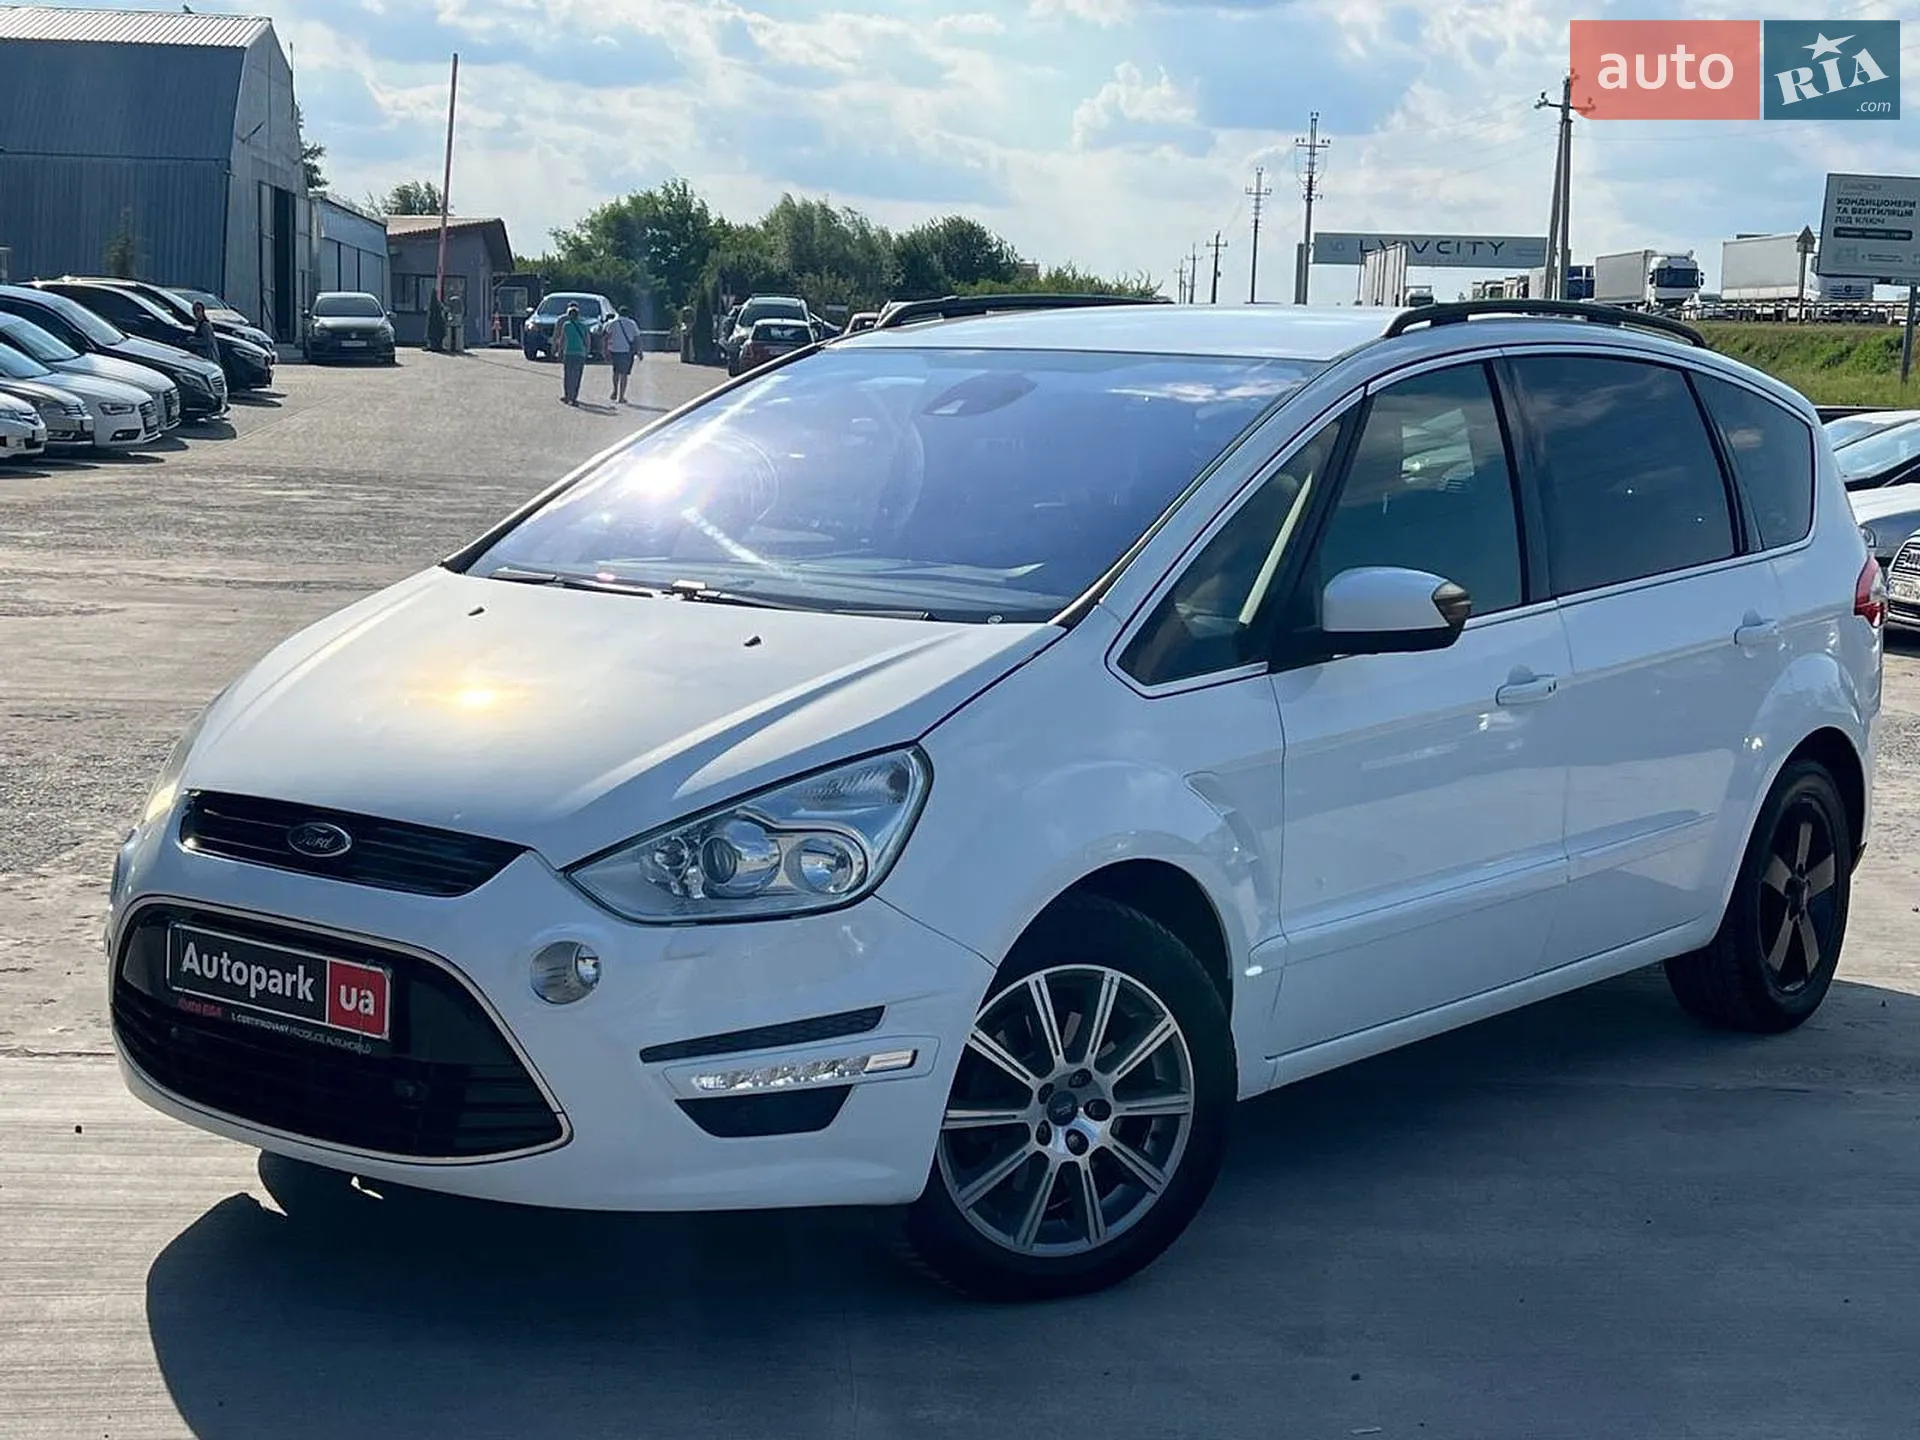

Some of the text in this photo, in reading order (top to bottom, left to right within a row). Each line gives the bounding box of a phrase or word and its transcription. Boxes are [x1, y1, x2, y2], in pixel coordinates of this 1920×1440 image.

[1835, 206, 1848, 215] ТА
[1358, 239, 1507, 256] LVVCITY
[180, 941, 375, 1017] Autopark ua
